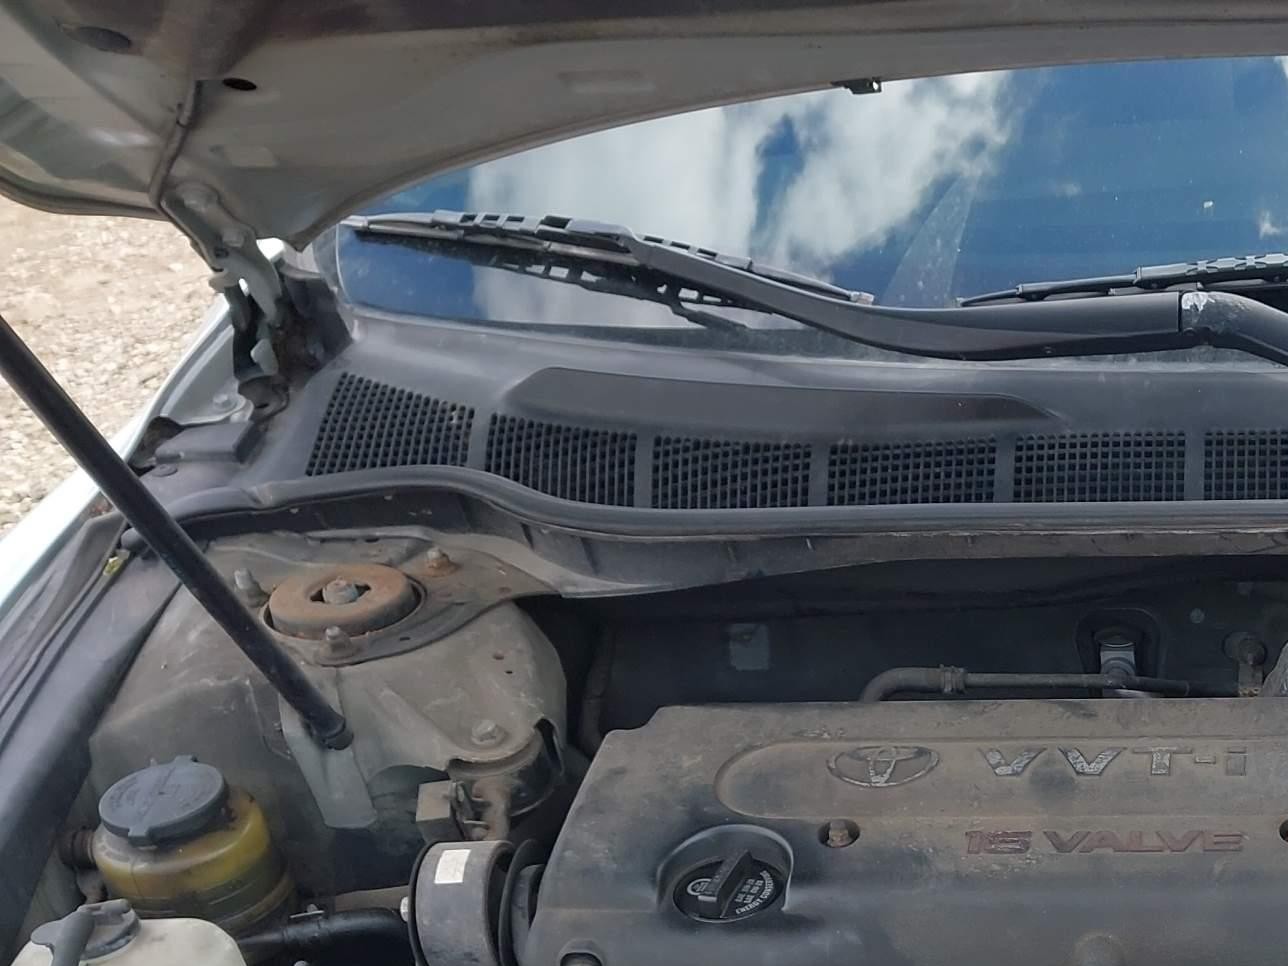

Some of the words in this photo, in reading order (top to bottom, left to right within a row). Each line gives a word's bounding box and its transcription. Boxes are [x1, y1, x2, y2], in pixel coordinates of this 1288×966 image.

[978, 746, 1247, 777] VVT-i
[965, 830, 1033, 854] 16
[1043, 830, 1249, 854] VALVE
[735, 898, 763, 914] ENERGY
